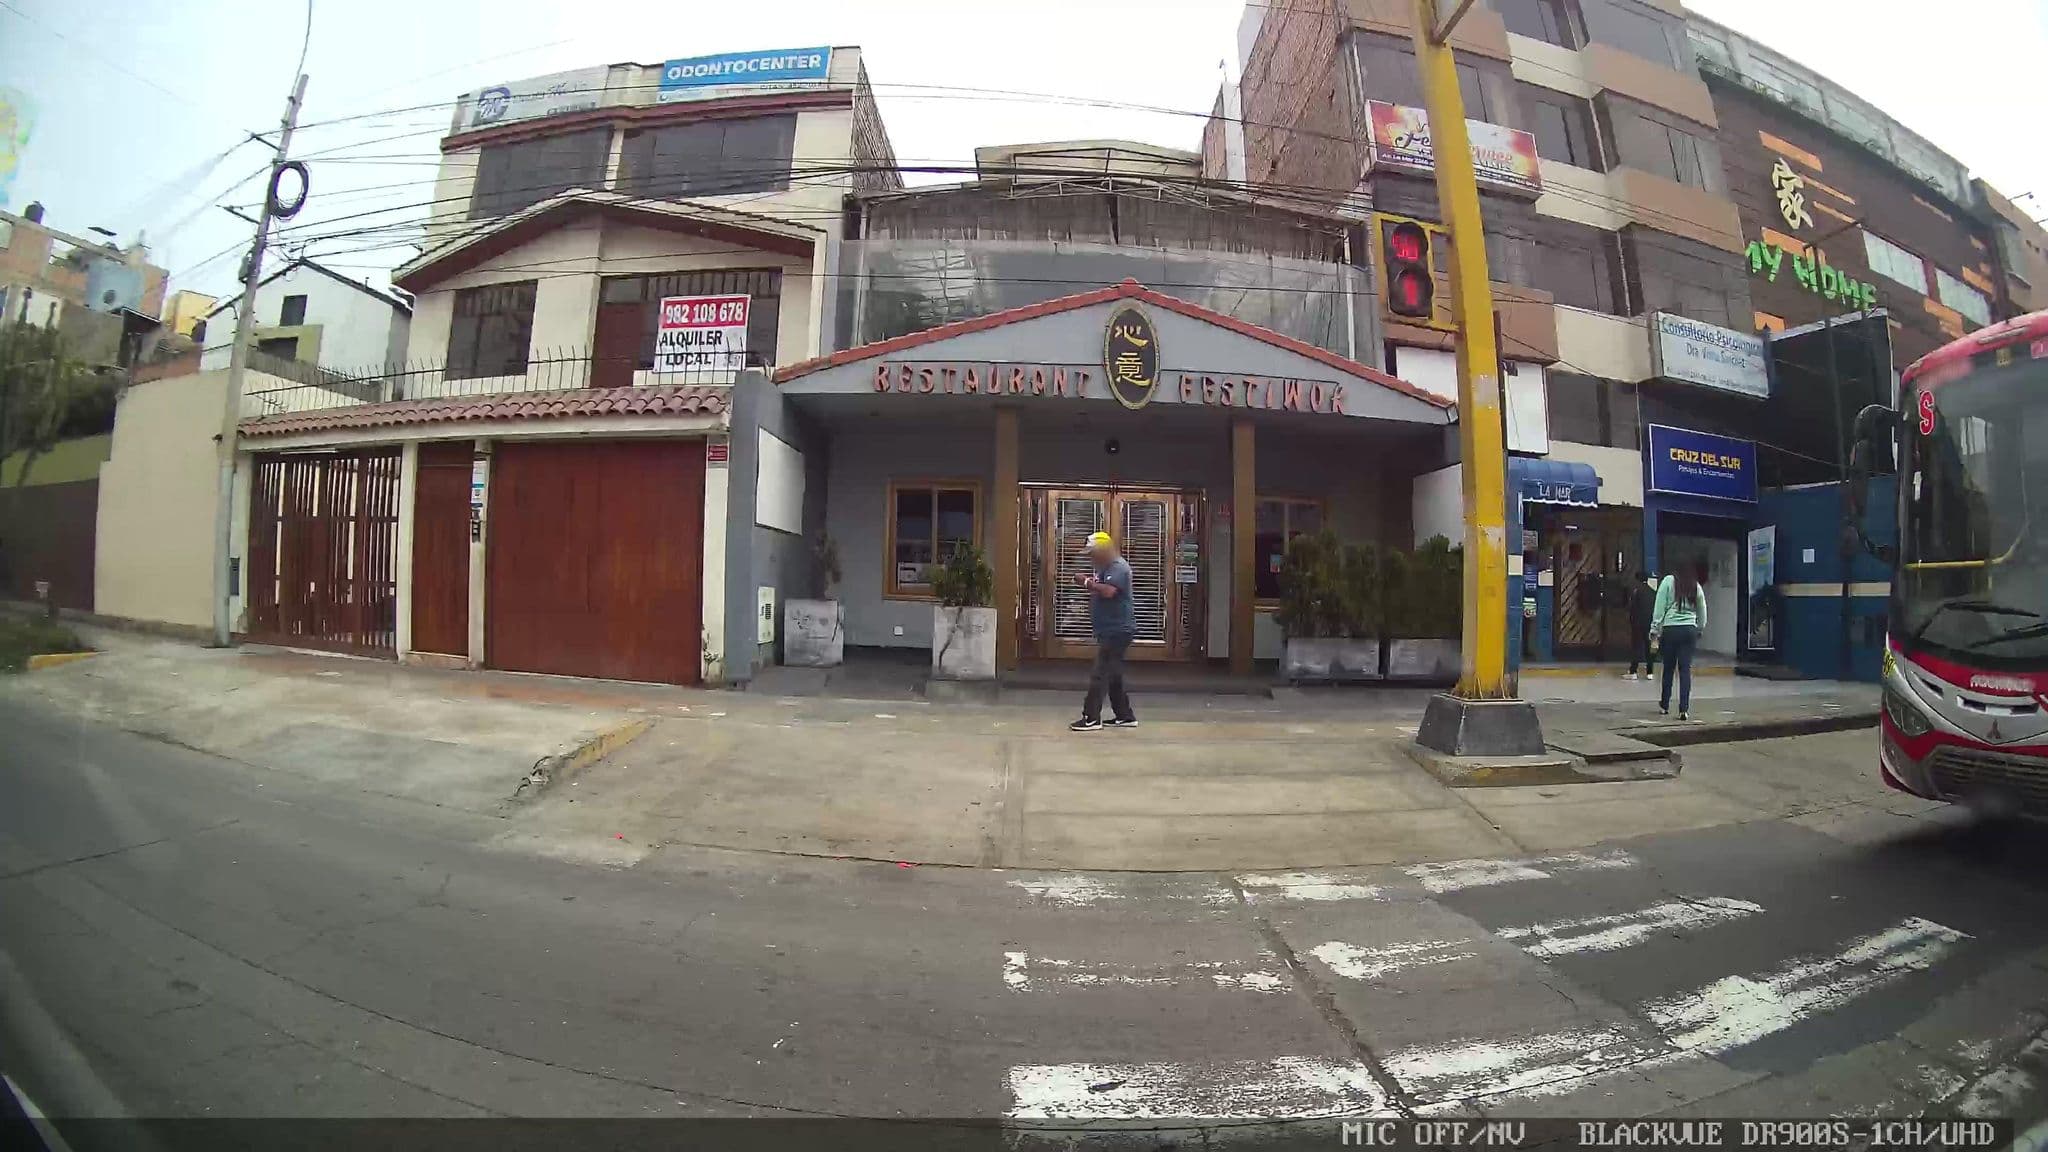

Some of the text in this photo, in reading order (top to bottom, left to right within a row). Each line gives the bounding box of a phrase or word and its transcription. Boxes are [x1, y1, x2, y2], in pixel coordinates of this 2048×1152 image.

[667, 54, 822, 80] ODONTOCENTER
[666, 301, 744, 324] 982 108 678
[660, 330, 723, 348] ALQUILER
[665, 352, 712, 366] LOCAL
[1114, 325, 1151, 387] 心意
[873, 362, 1346, 415] RESTAURANT FESTIWOK
[1919, 390, 1935, 435] S
[1669, 447, 1741, 471] CRUZ DEL SUR
